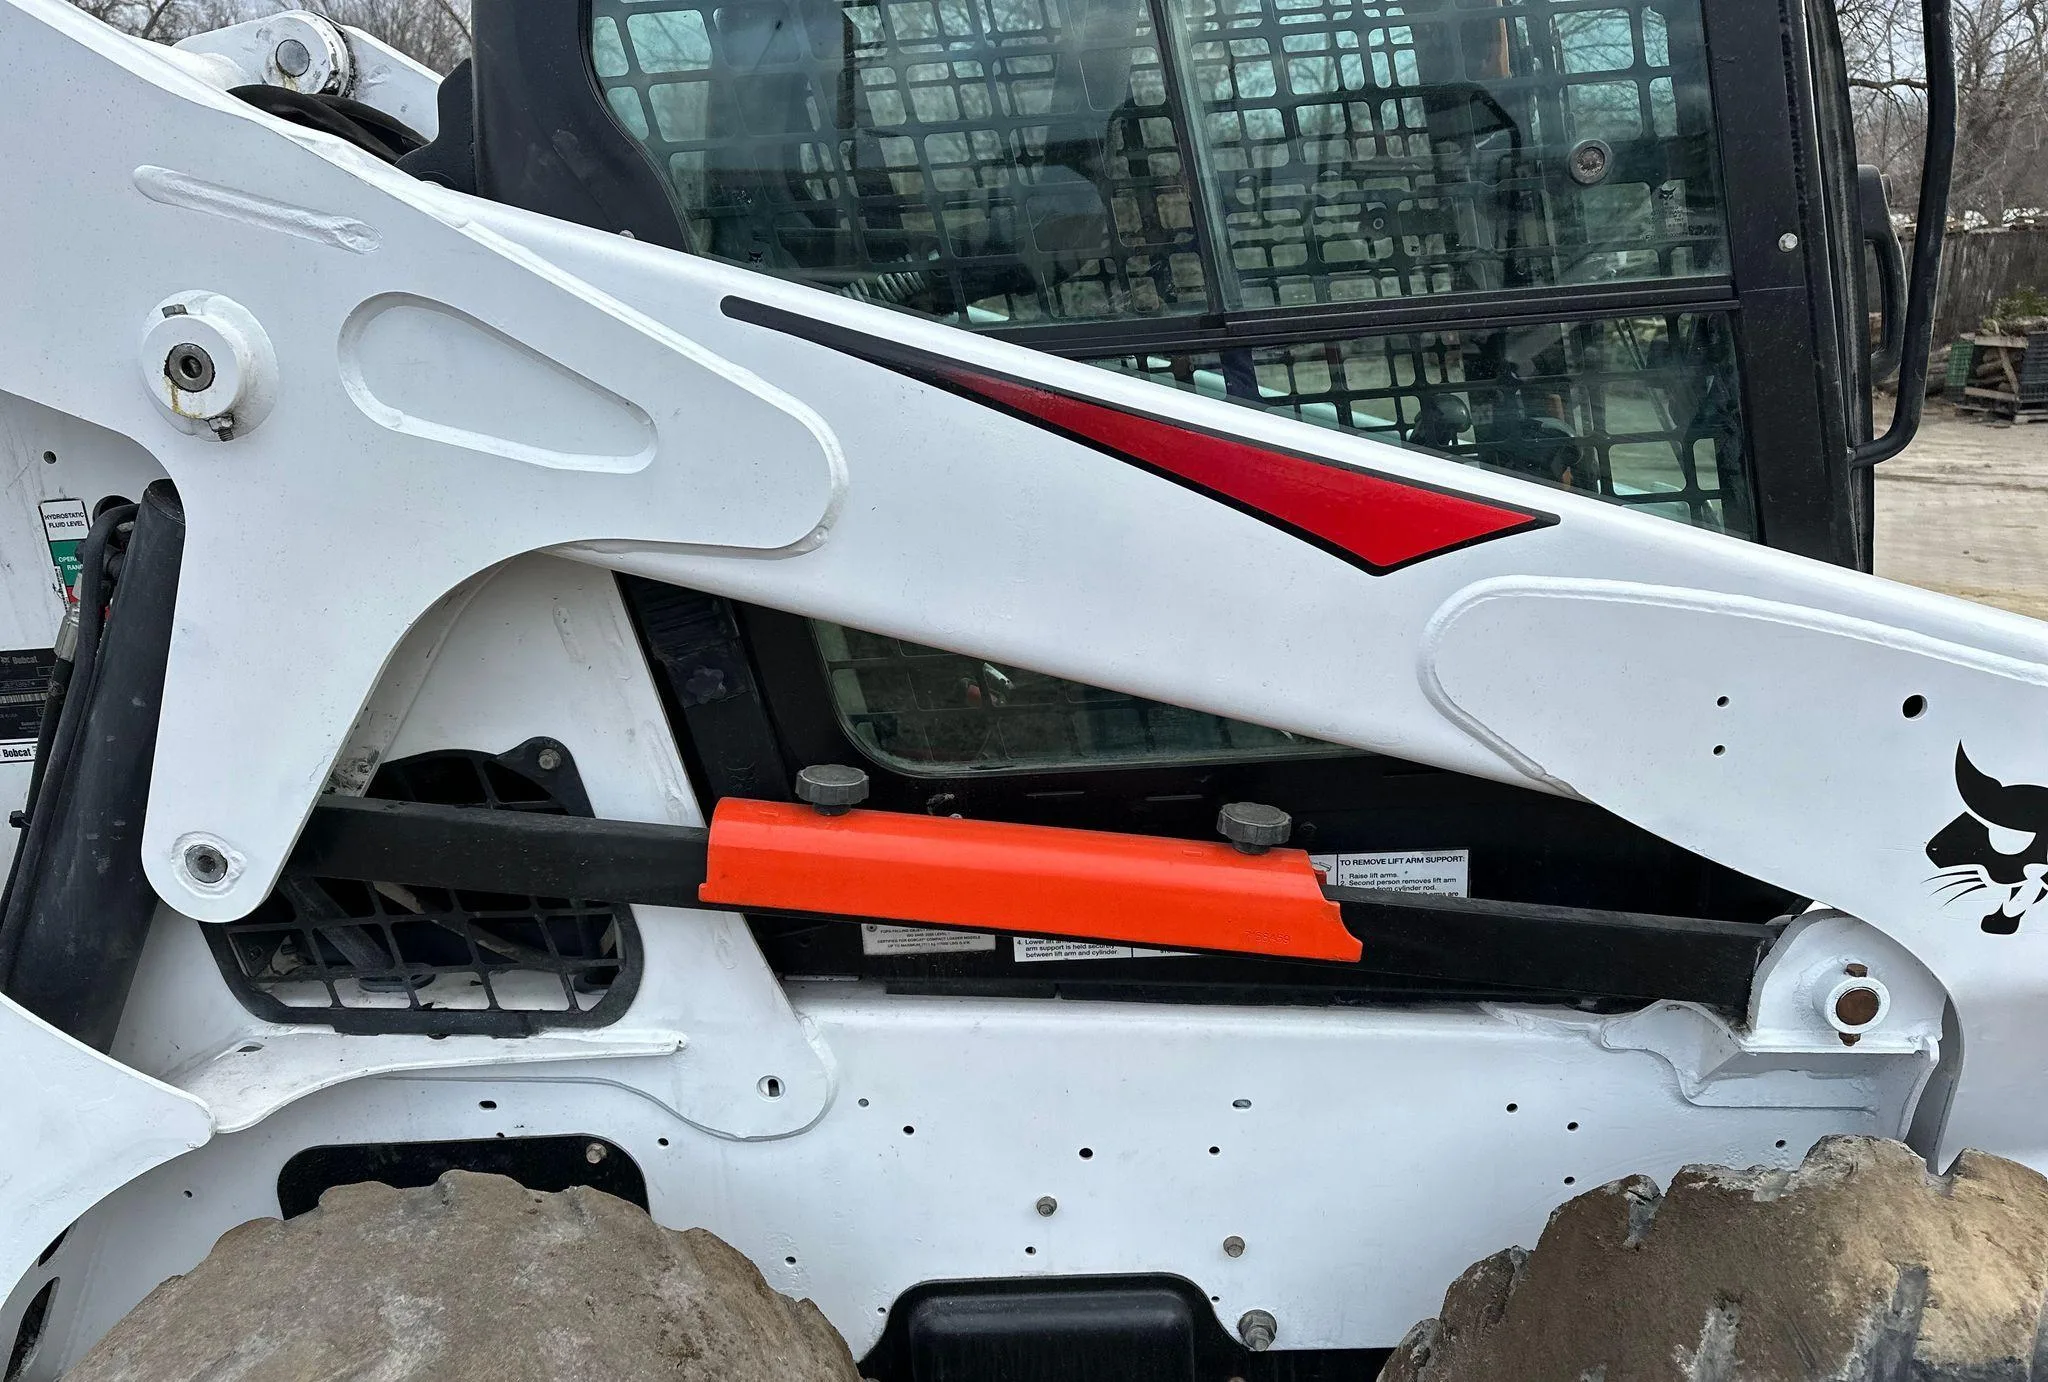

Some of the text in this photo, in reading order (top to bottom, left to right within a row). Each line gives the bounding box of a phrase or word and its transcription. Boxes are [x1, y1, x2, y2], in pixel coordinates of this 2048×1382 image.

[44, 512, 84, 520] HYDROSTATIC
[2, 748, 32, 758] Bobcat
[1352, 858, 1387, 866] REMOVE
[1388, 857, 1404, 865] LIFT
[1425, 855, 1465, 863] SUPPORT:
